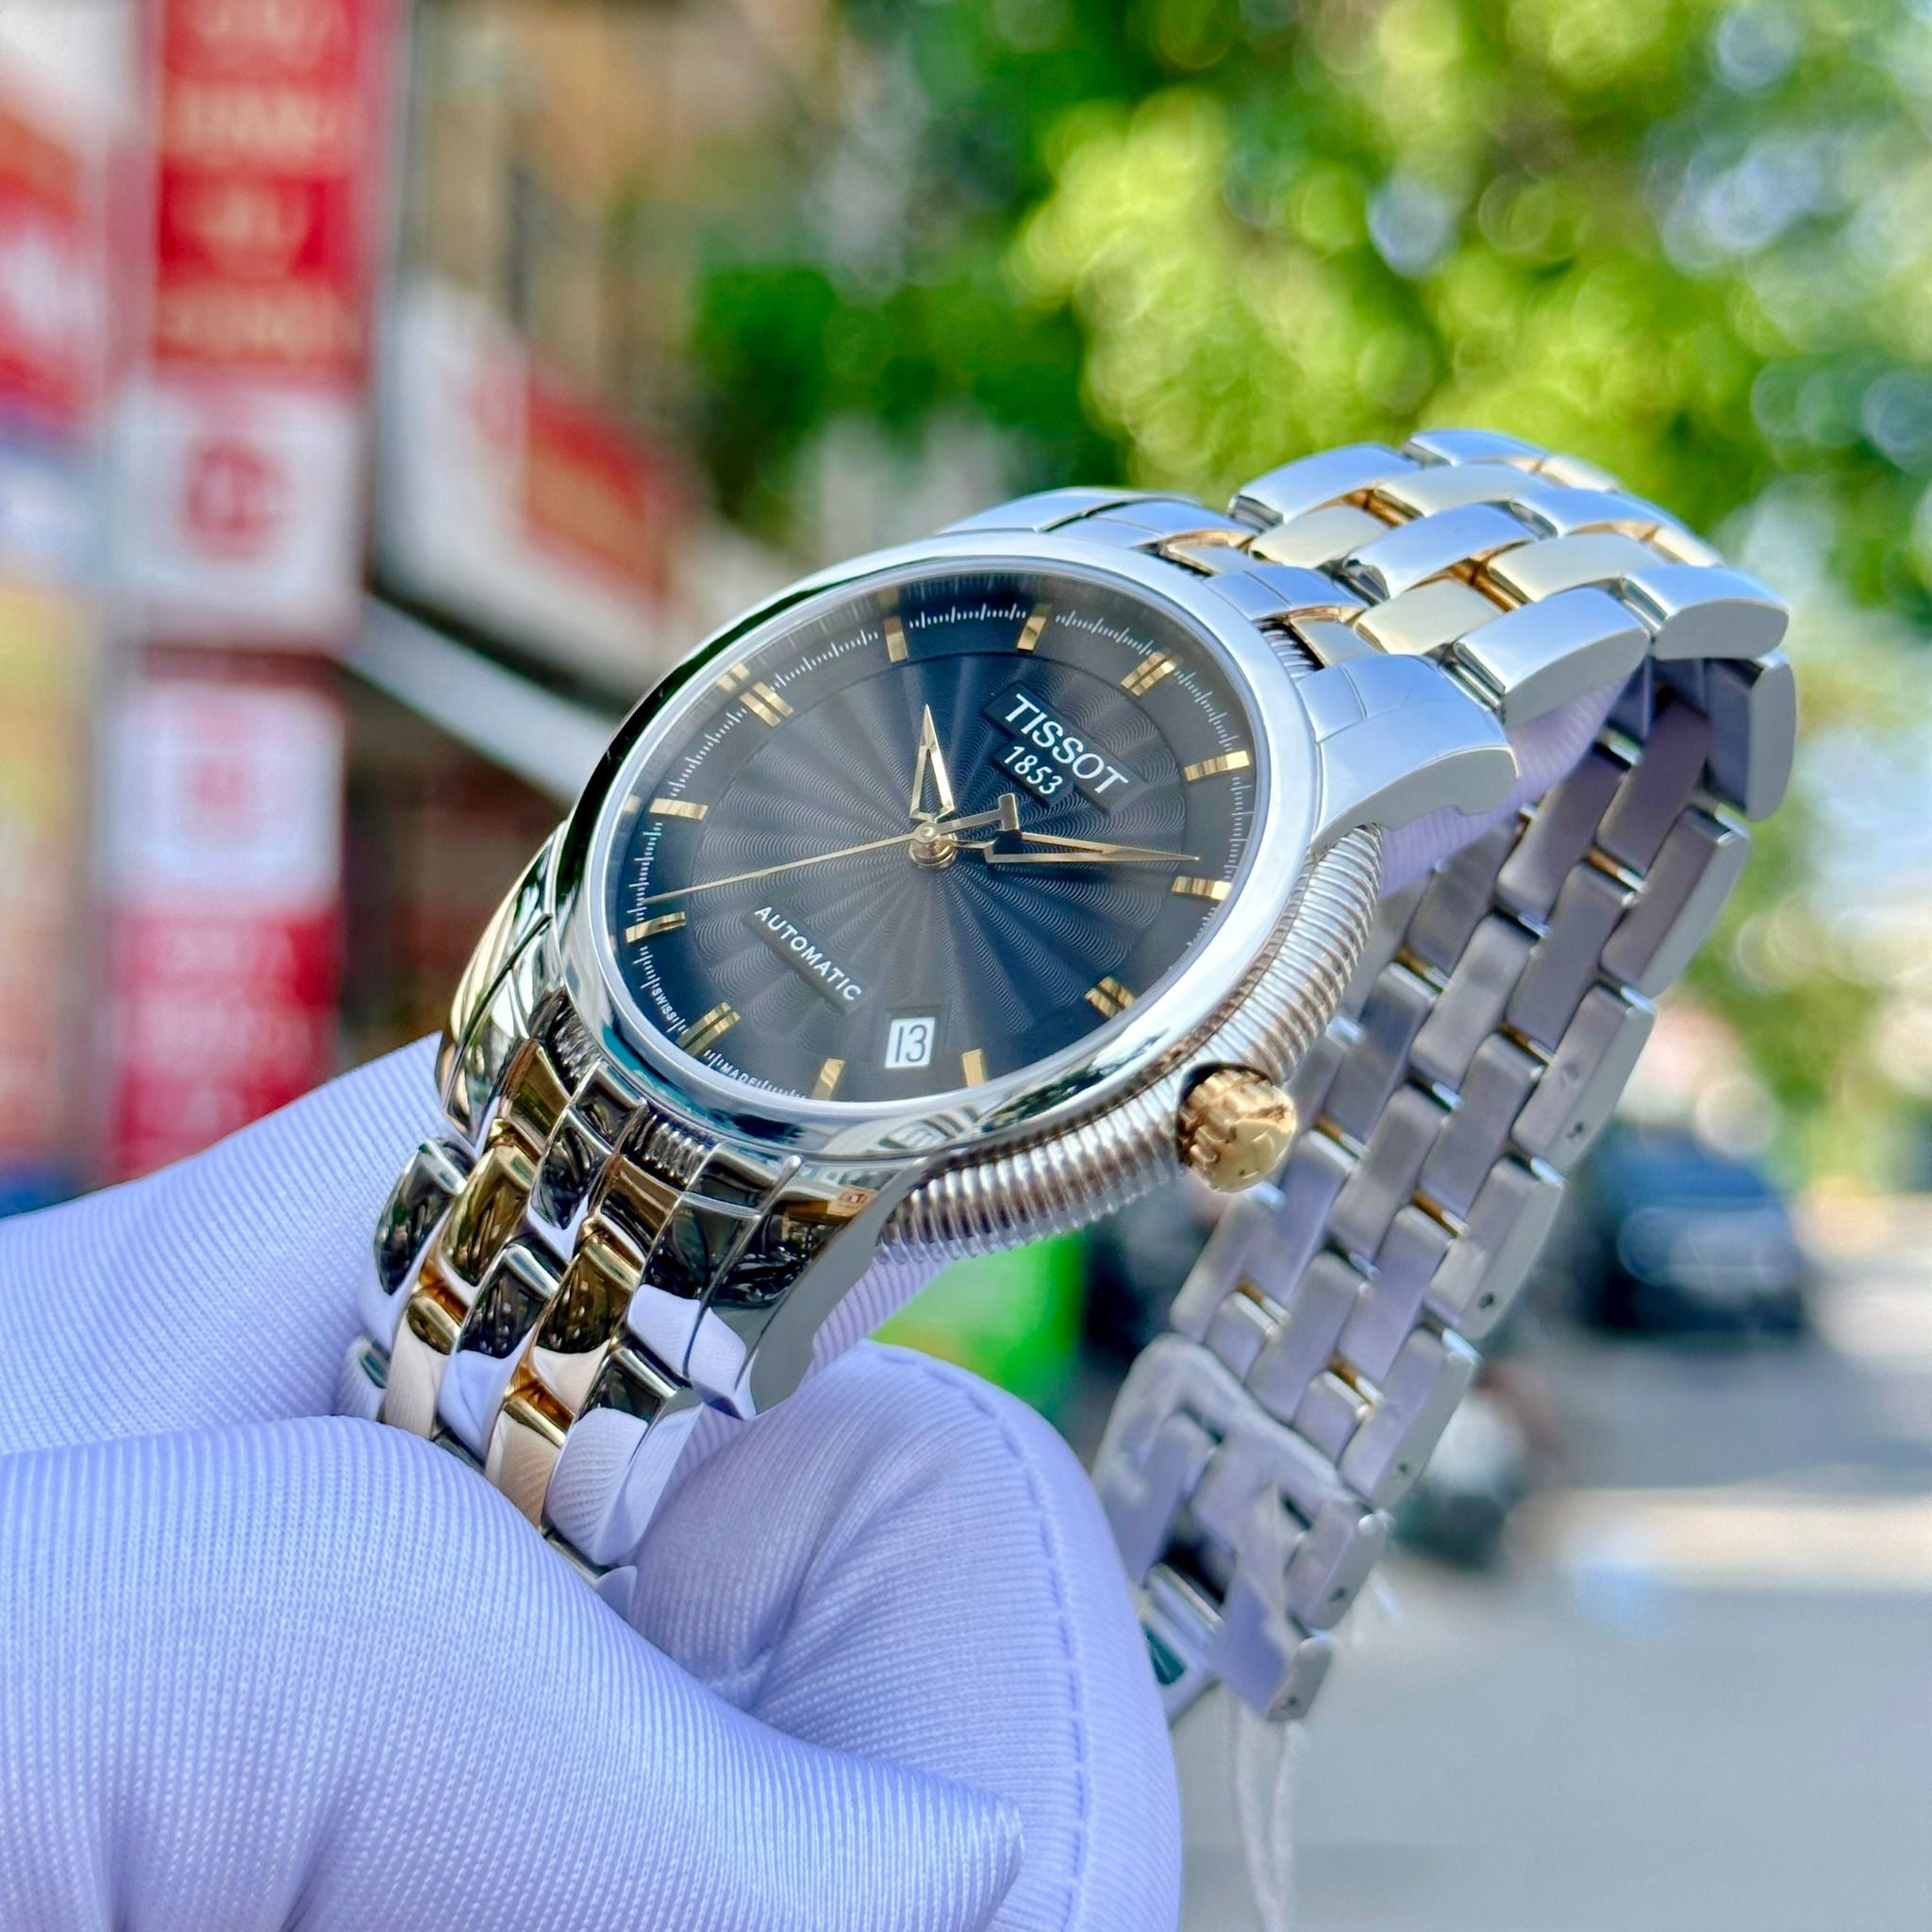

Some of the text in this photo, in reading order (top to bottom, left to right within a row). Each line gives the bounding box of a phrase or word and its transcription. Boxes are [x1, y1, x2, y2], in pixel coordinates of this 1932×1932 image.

[1003, 745, 1063, 794] 1853
[1005, 693, 1129, 793] TISSOT
[754, 906, 862, 1001] AUTOMATIC
[652, 987, 758, 1088] SWISS MADE
[894, 1024, 927, 1063] 13
